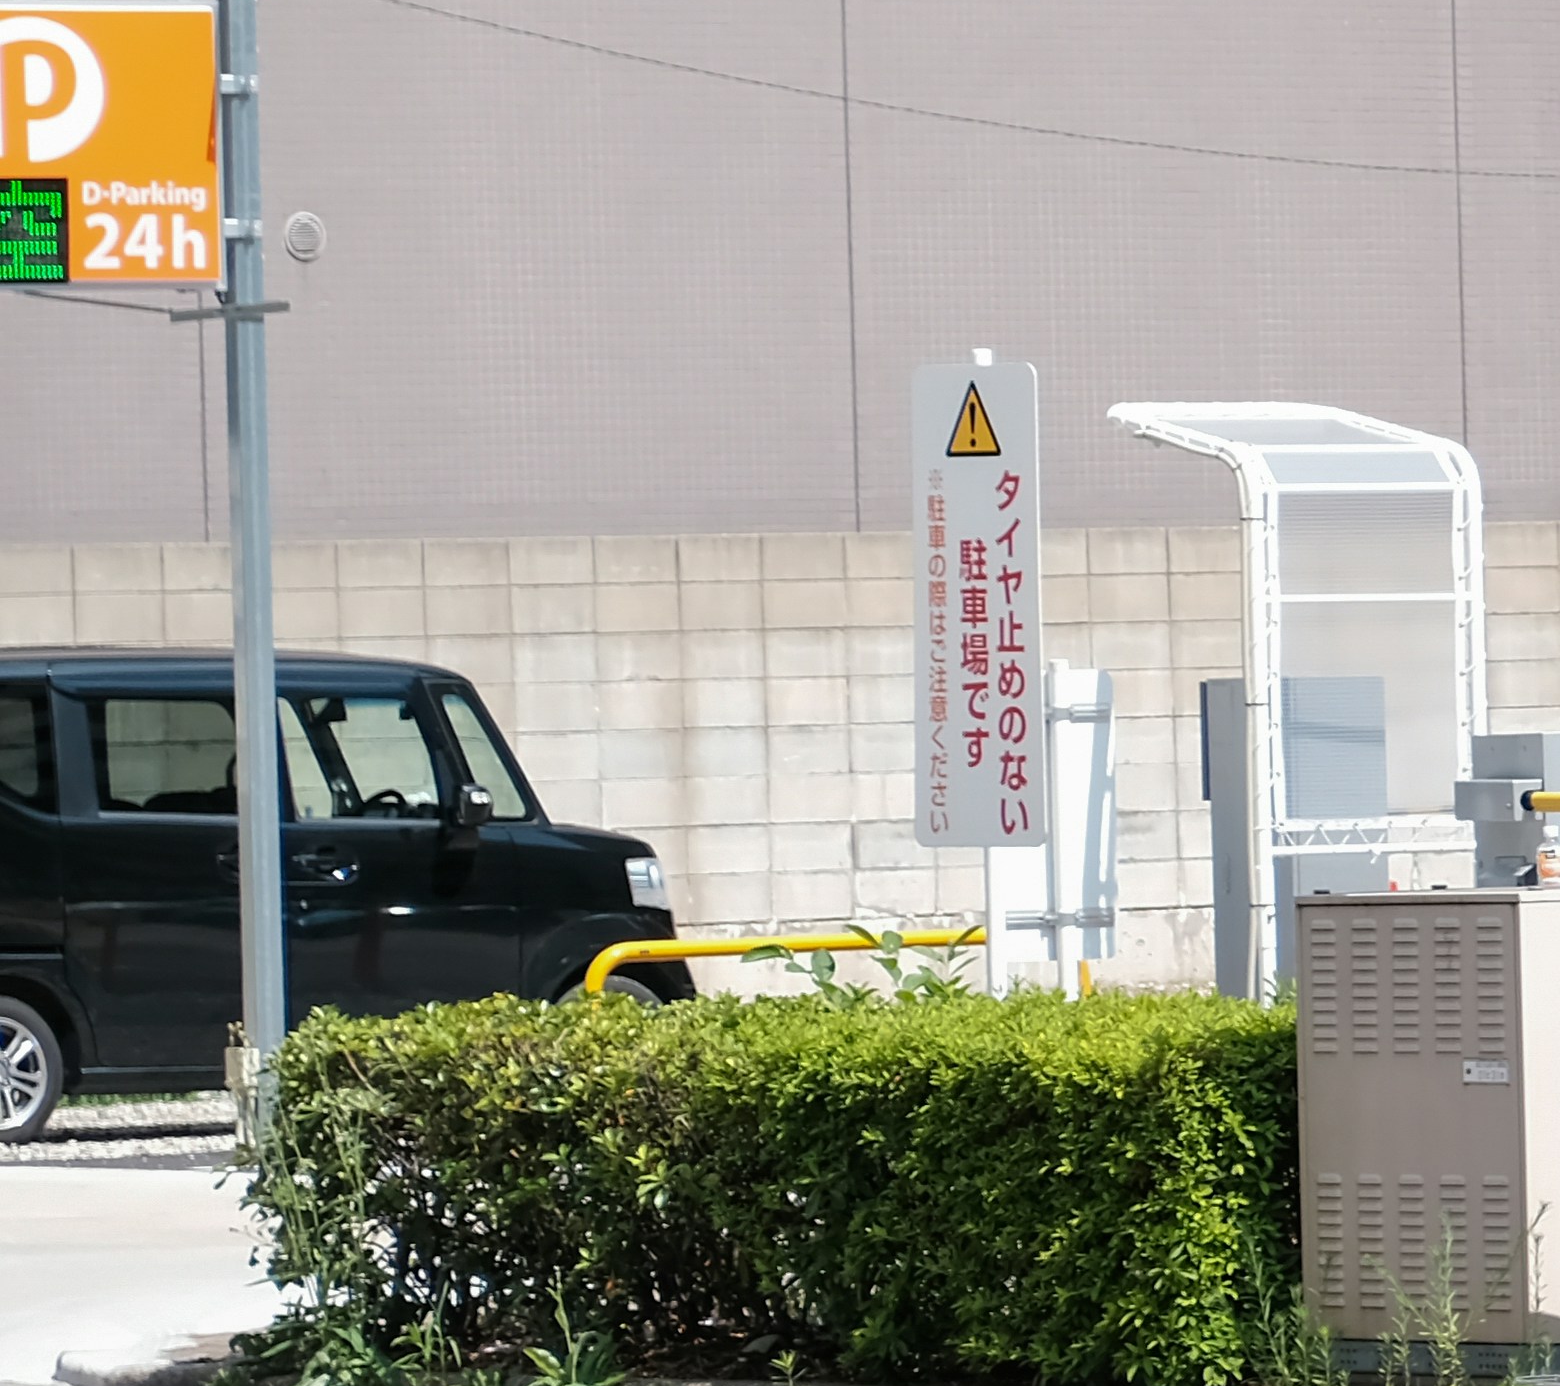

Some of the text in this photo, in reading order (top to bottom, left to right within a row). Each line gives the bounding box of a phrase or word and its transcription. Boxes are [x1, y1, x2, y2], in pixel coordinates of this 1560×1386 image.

[82, 180, 206, 211] D-Parking
[84, 213, 206, 270] 24h
[959, 537, 989, 768] 駐車場です
[995, 470, 1029, 835] タイヤ止めのない
